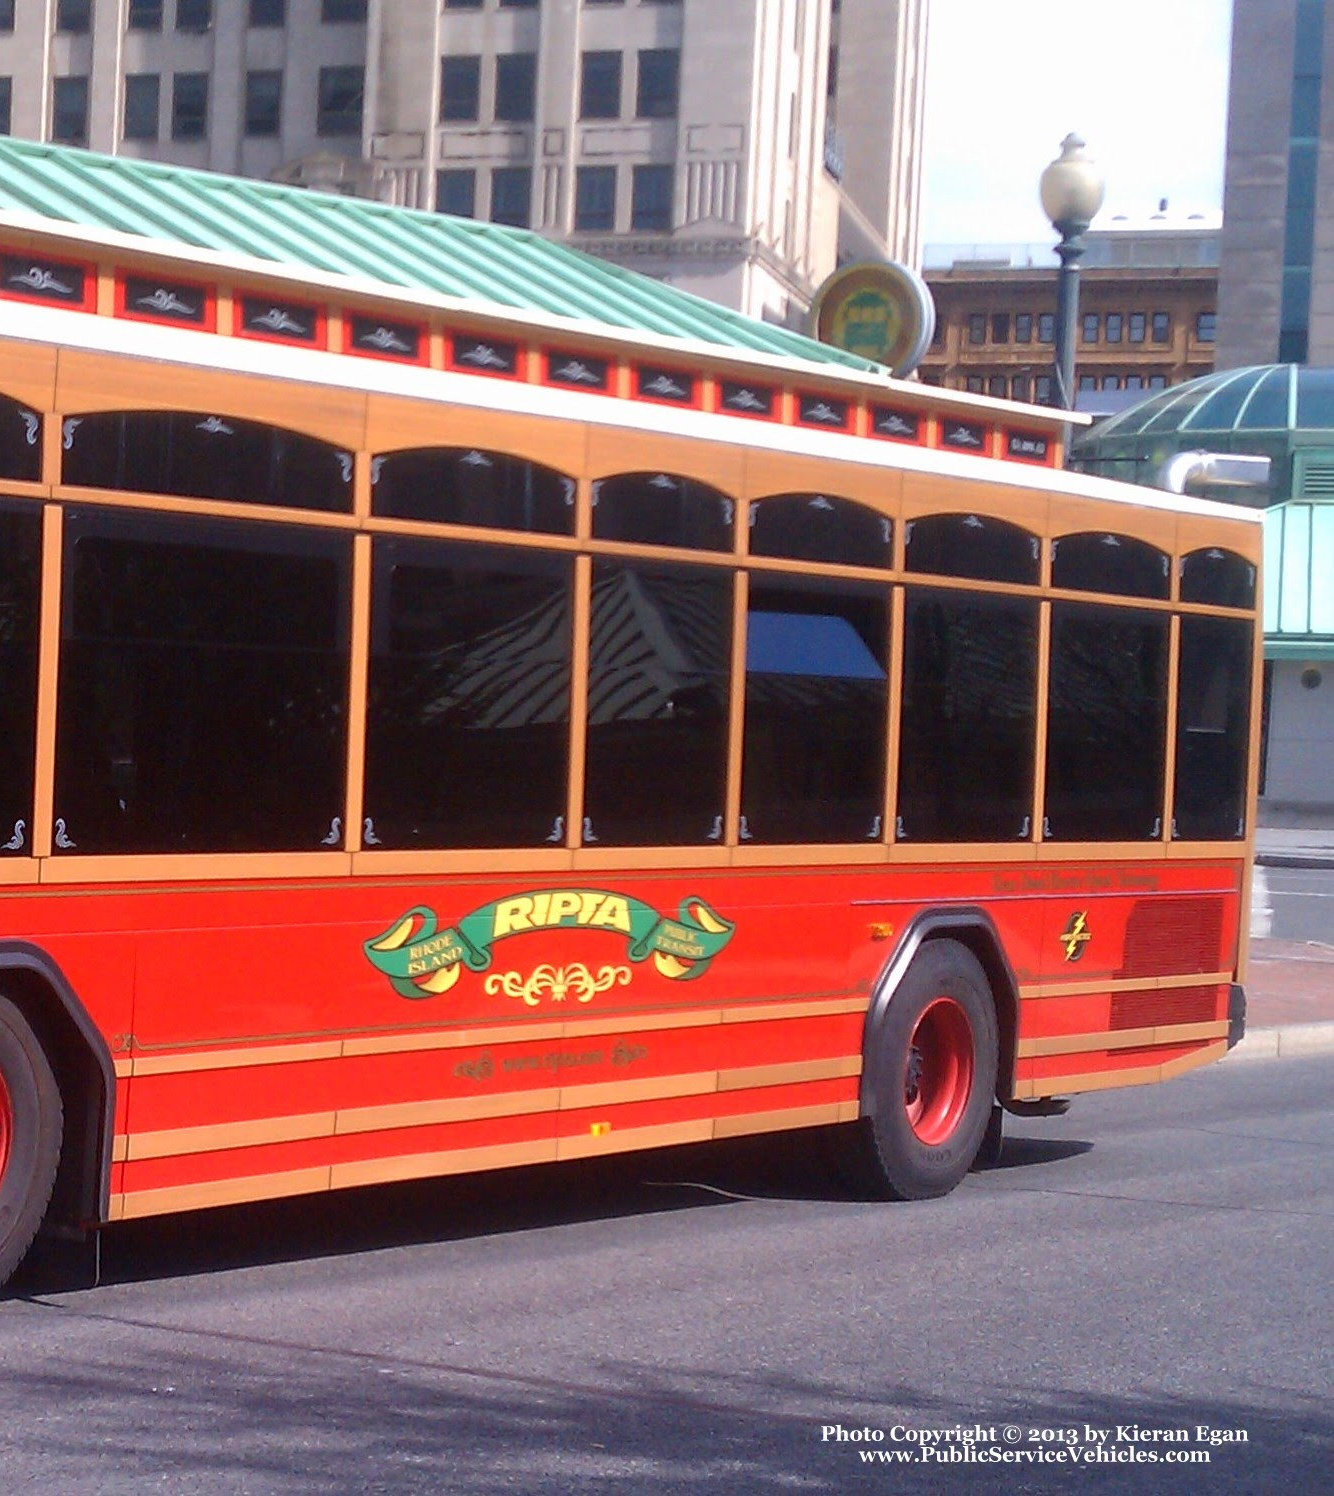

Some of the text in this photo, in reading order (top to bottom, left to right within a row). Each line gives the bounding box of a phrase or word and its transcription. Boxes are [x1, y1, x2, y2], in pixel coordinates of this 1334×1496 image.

[493, 892, 631, 938] RIPTA
[409, 934, 454, 959] RHODE
[407, 947, 463, 975] ISLAND
